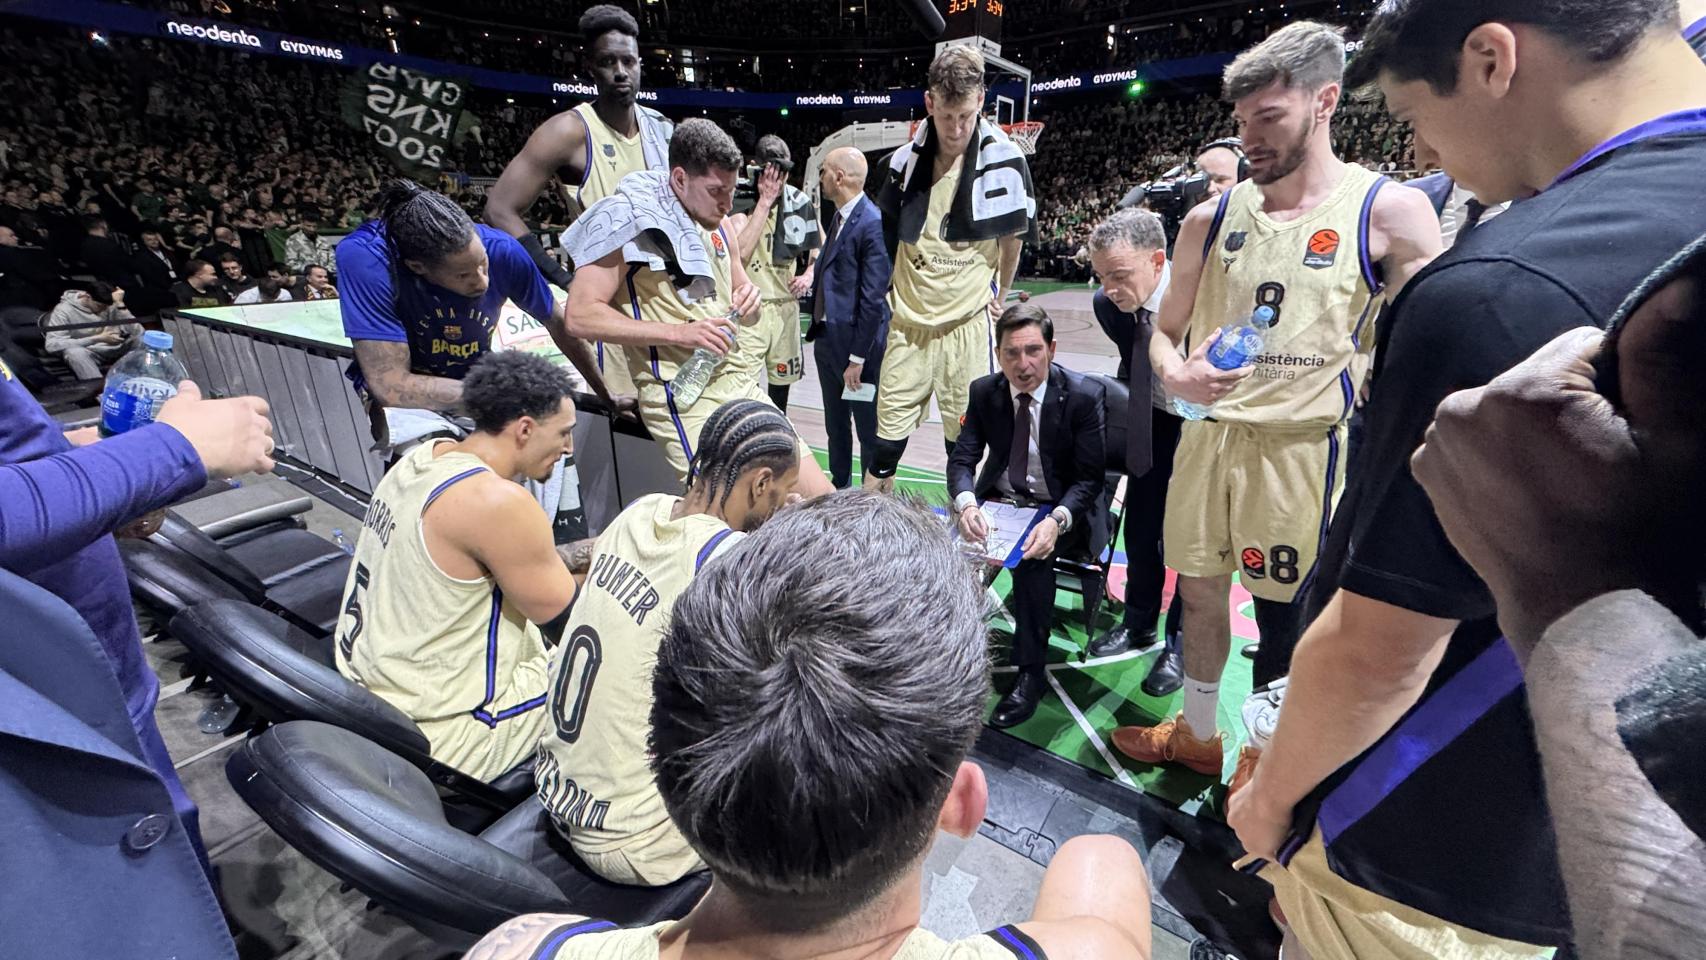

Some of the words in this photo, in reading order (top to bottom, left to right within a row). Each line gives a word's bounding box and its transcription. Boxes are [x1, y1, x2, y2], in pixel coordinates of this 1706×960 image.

[166, 21, 262, 48] neodenta
[280, 40, 344, 60] GYDYMAS
[796, 94, 844, 105] neodenta
[853, 95, 891, 104] GYDYMAS
[1031, 75, 1082, 93] neodenta
[1093, 70, 1137, 84] GYDYMAS
[1253, 281, 1285, 328] 8
[431, 338, 480, 359] BARÇA
[1254, 351, 1325, 367] sistència
[1252, 366, 1296, 380] nitària
[1269, 544, 1299, 585] 8
[588, 553, 660, 627] PUNTER
[339, 560, 371, 662] 5
[552, 624, 603, 745] 0
